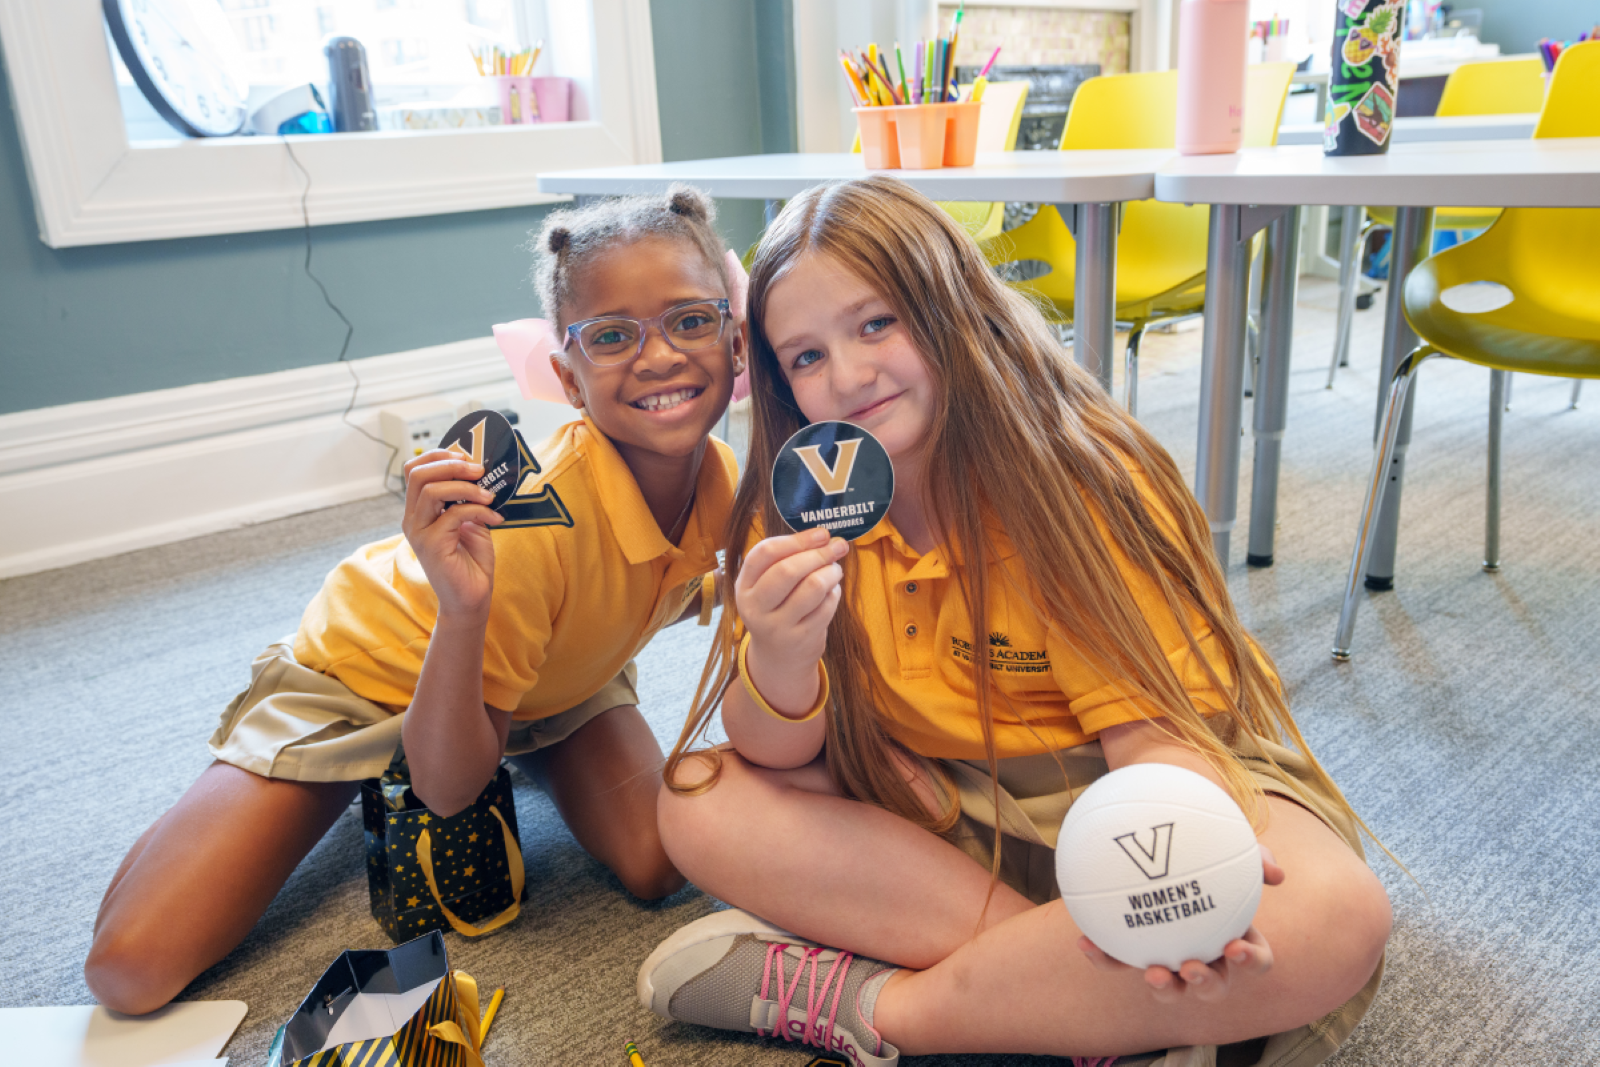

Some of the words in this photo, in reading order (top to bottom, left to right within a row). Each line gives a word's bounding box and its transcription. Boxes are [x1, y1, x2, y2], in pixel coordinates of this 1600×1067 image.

[792, 437, 865, 496] V
[801, 501, 875, 523] VANDERBILT
[996, 649, 1047, 661] ACADEM
[1113, 822, 1175, 880] V
[1124, 894, 1217, 928] BASKETBALL
[1127, 880, 1202, 910] WOMEN'S
